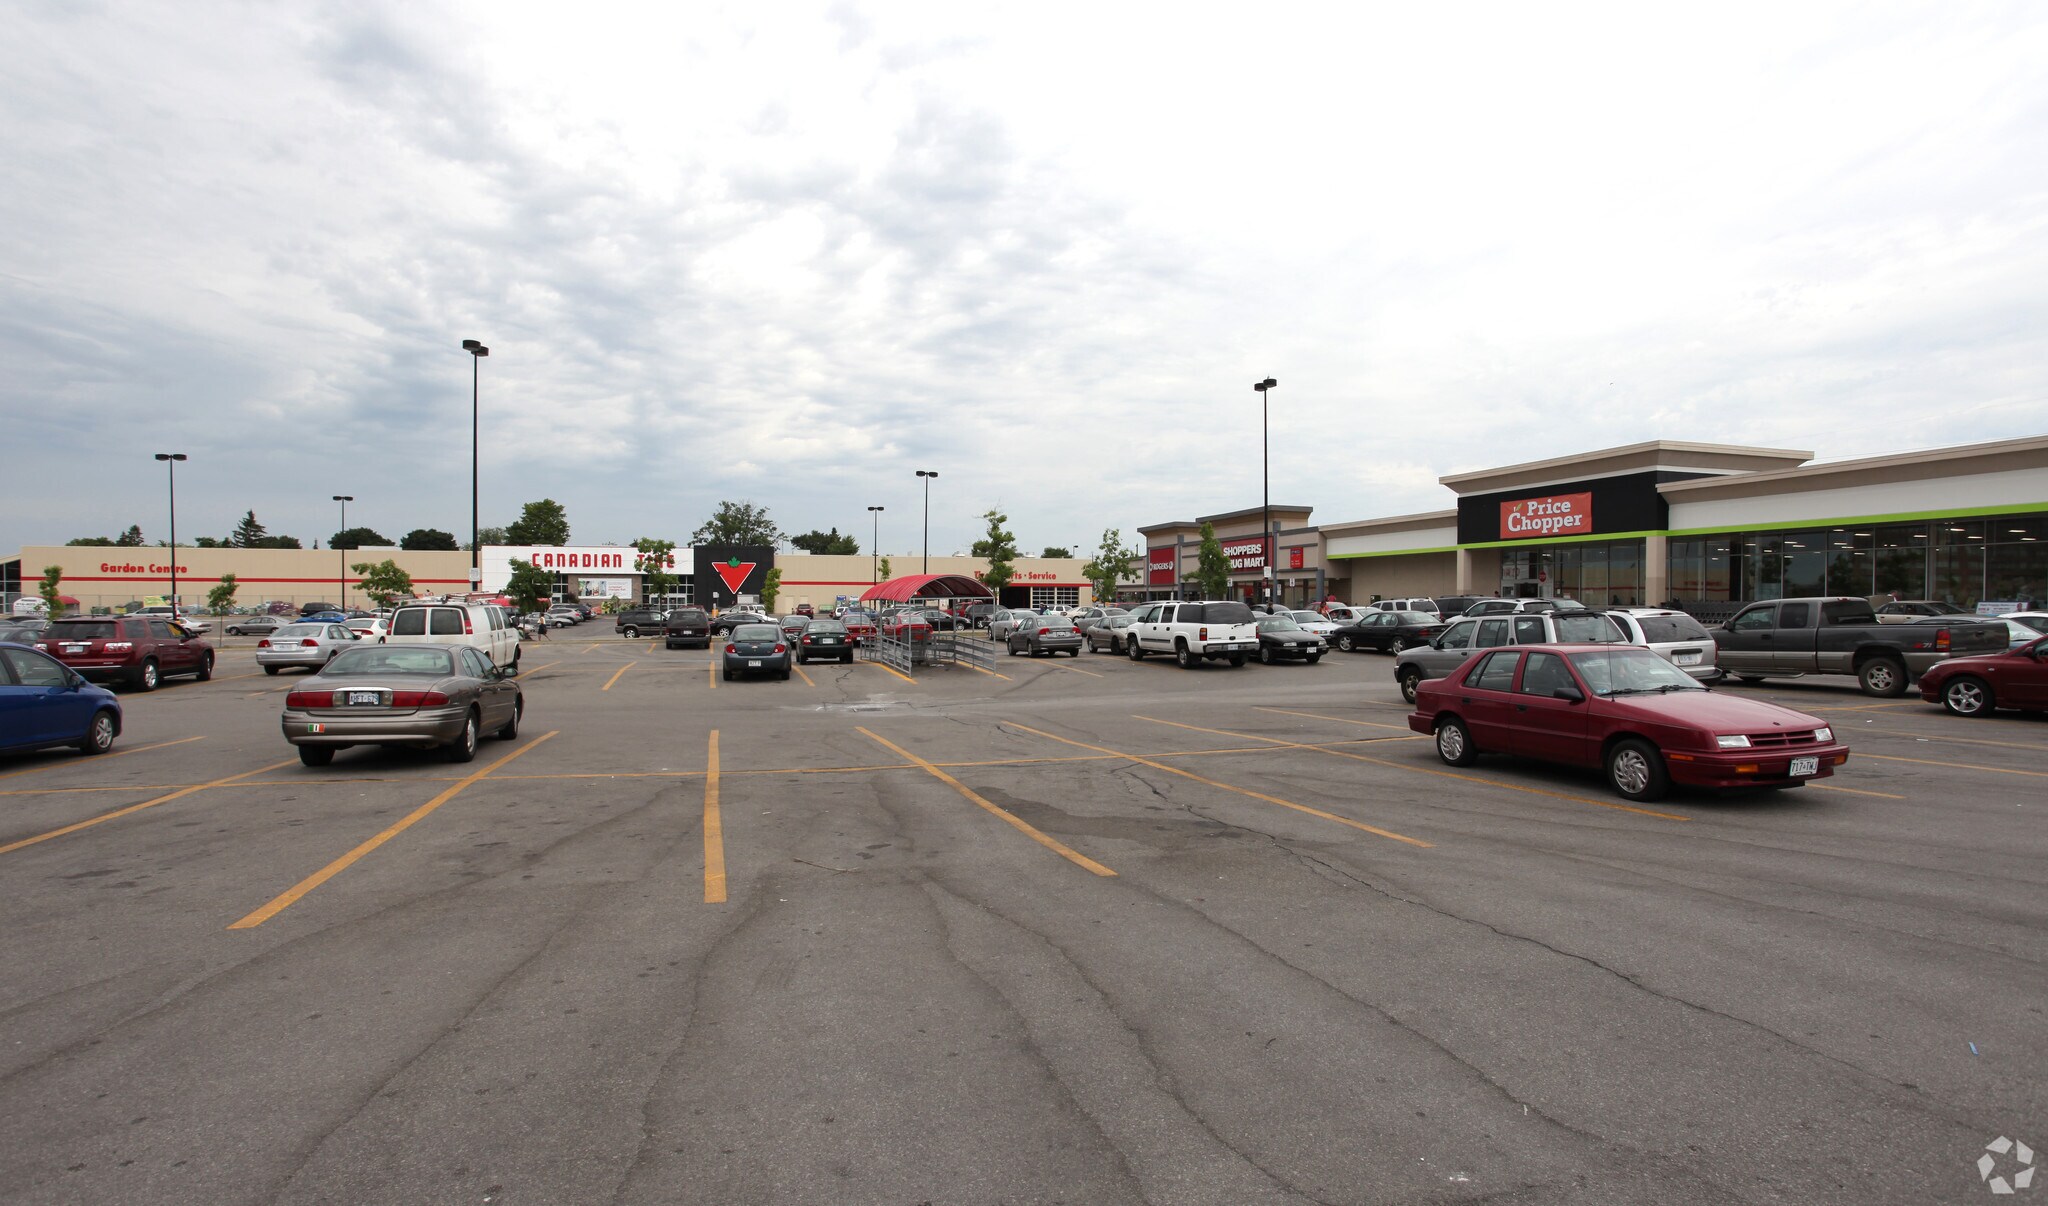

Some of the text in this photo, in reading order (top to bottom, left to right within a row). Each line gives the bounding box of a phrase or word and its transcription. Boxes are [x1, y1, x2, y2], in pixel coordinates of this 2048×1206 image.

[1527, 499, 1571, 516] Price
[1508, 513, 1582, 533] Chopper
[1223, 543, 1262, 557] SHOPPERS
[532, 553, 675, 568] CANADIAN TE
[1230, 556, 1265, 569] RUG MART
[101, 563, 188, 573] Garden Cenre
[1028, 572, 1056, 580] Service
